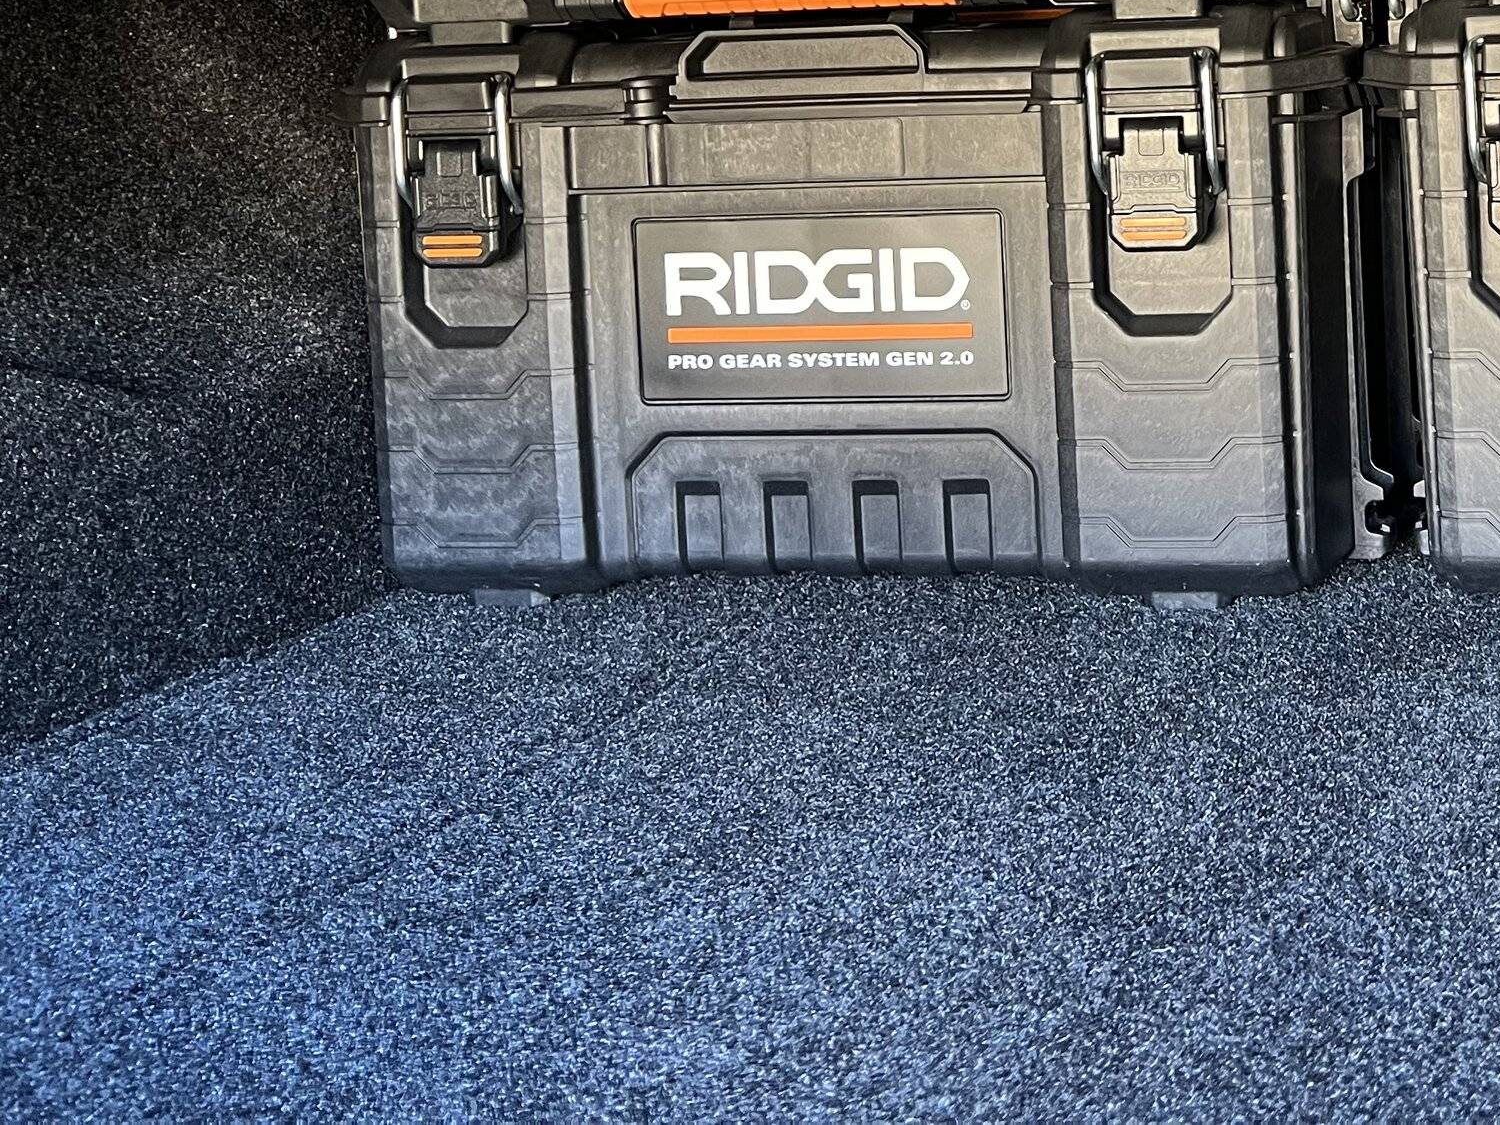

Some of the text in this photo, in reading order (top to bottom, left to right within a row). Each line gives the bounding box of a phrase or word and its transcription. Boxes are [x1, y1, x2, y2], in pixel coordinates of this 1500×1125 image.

[664, 247, 970, 316] RIDGID
[667, 350, 974, 370] PRO GEAR SYSTEM GEN 2.0
